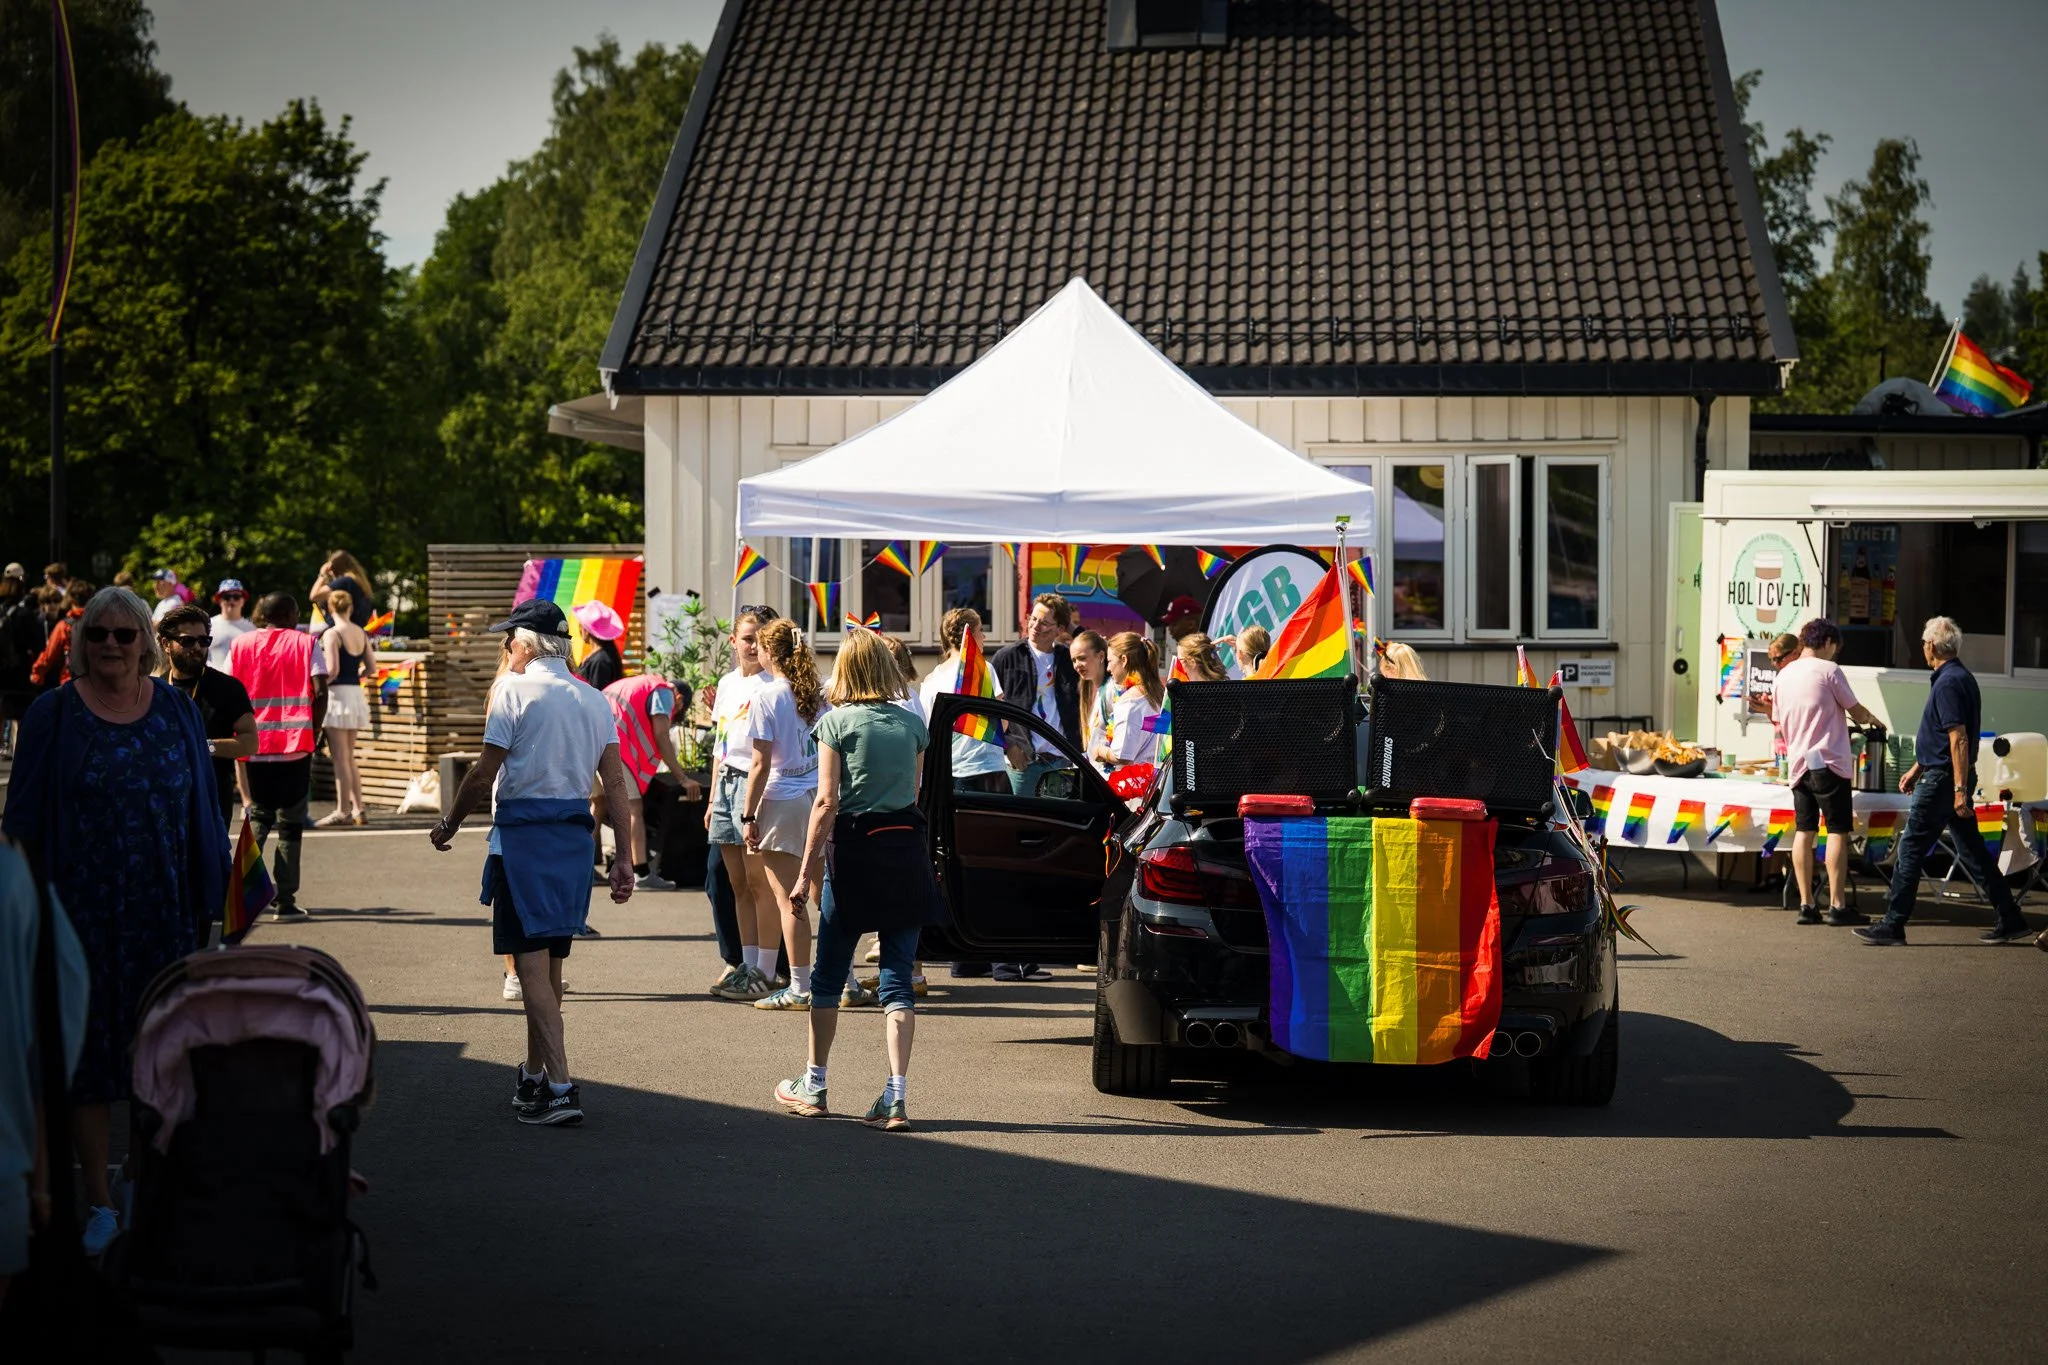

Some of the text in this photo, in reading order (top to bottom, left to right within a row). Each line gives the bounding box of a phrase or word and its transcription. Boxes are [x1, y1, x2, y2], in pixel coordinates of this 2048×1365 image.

[1728, 581, 1753, 605] HØL
[1766, 583, 1810, 607] CV-EN
[1565, 666, 1576, 680] P
[1185, 739, 1196, 792] SOUNDBOKS
[1381, 736, 1394, 789] SOUNDBOKS
[548, 1096, 570, 1108] HOKA
